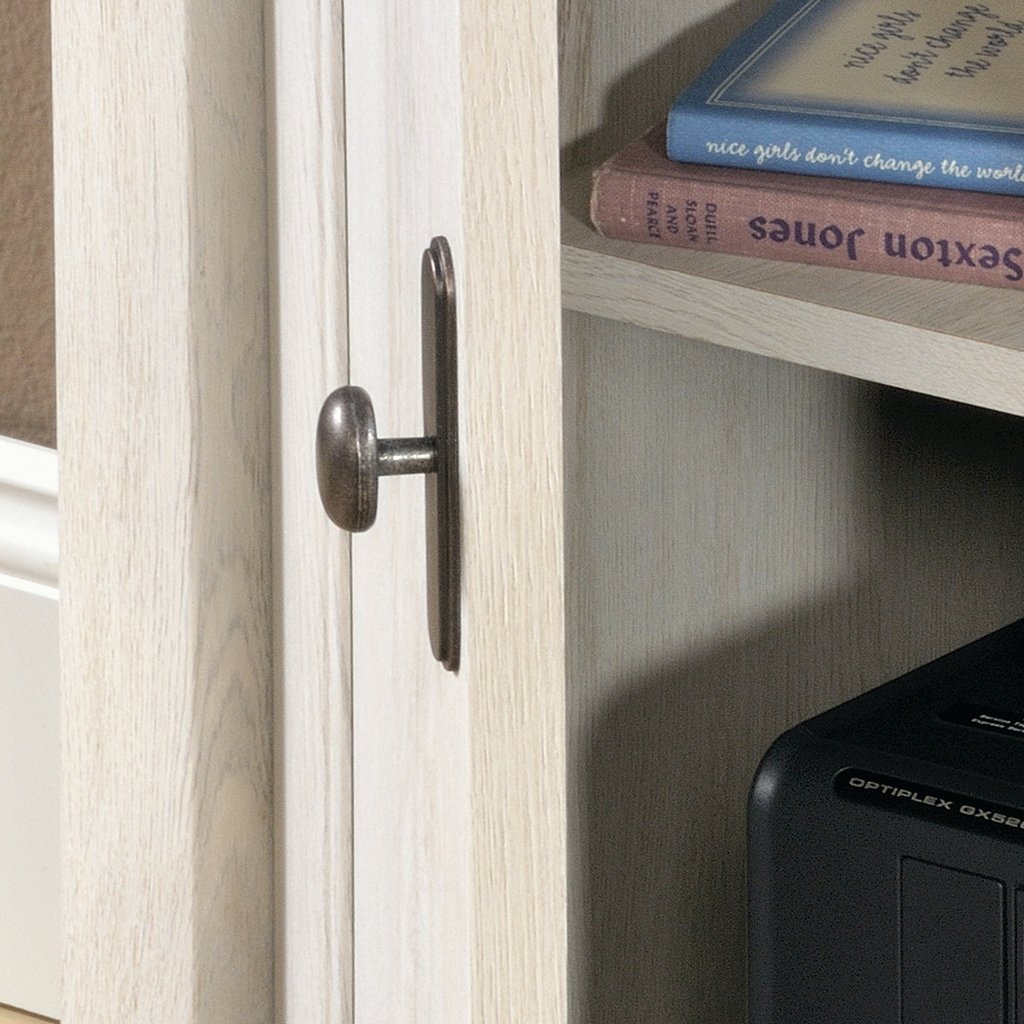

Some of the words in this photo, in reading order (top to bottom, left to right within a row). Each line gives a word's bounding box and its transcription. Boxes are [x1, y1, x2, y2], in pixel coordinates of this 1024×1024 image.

[844, 42, 887, 69] nice
[871, 10, 922, 41] girls
[884, 50, 938, 84] don't
[924, 4, 1000, 49] change
[944, 59, 991, 78] the
[706, 138, 750, 157] nice
[753, 142, 801, 165] girls
[805, 147, 859, 166] don't
[863, 153, 936, 180] change
[940, 158, 972, 178] the
[665, 204, 679, 234] AND
[749, 216, 865, 260] Jones
[883, 231, 1024, 281] Sexton
[849, 777, 953, 810] OPTIPLEX
